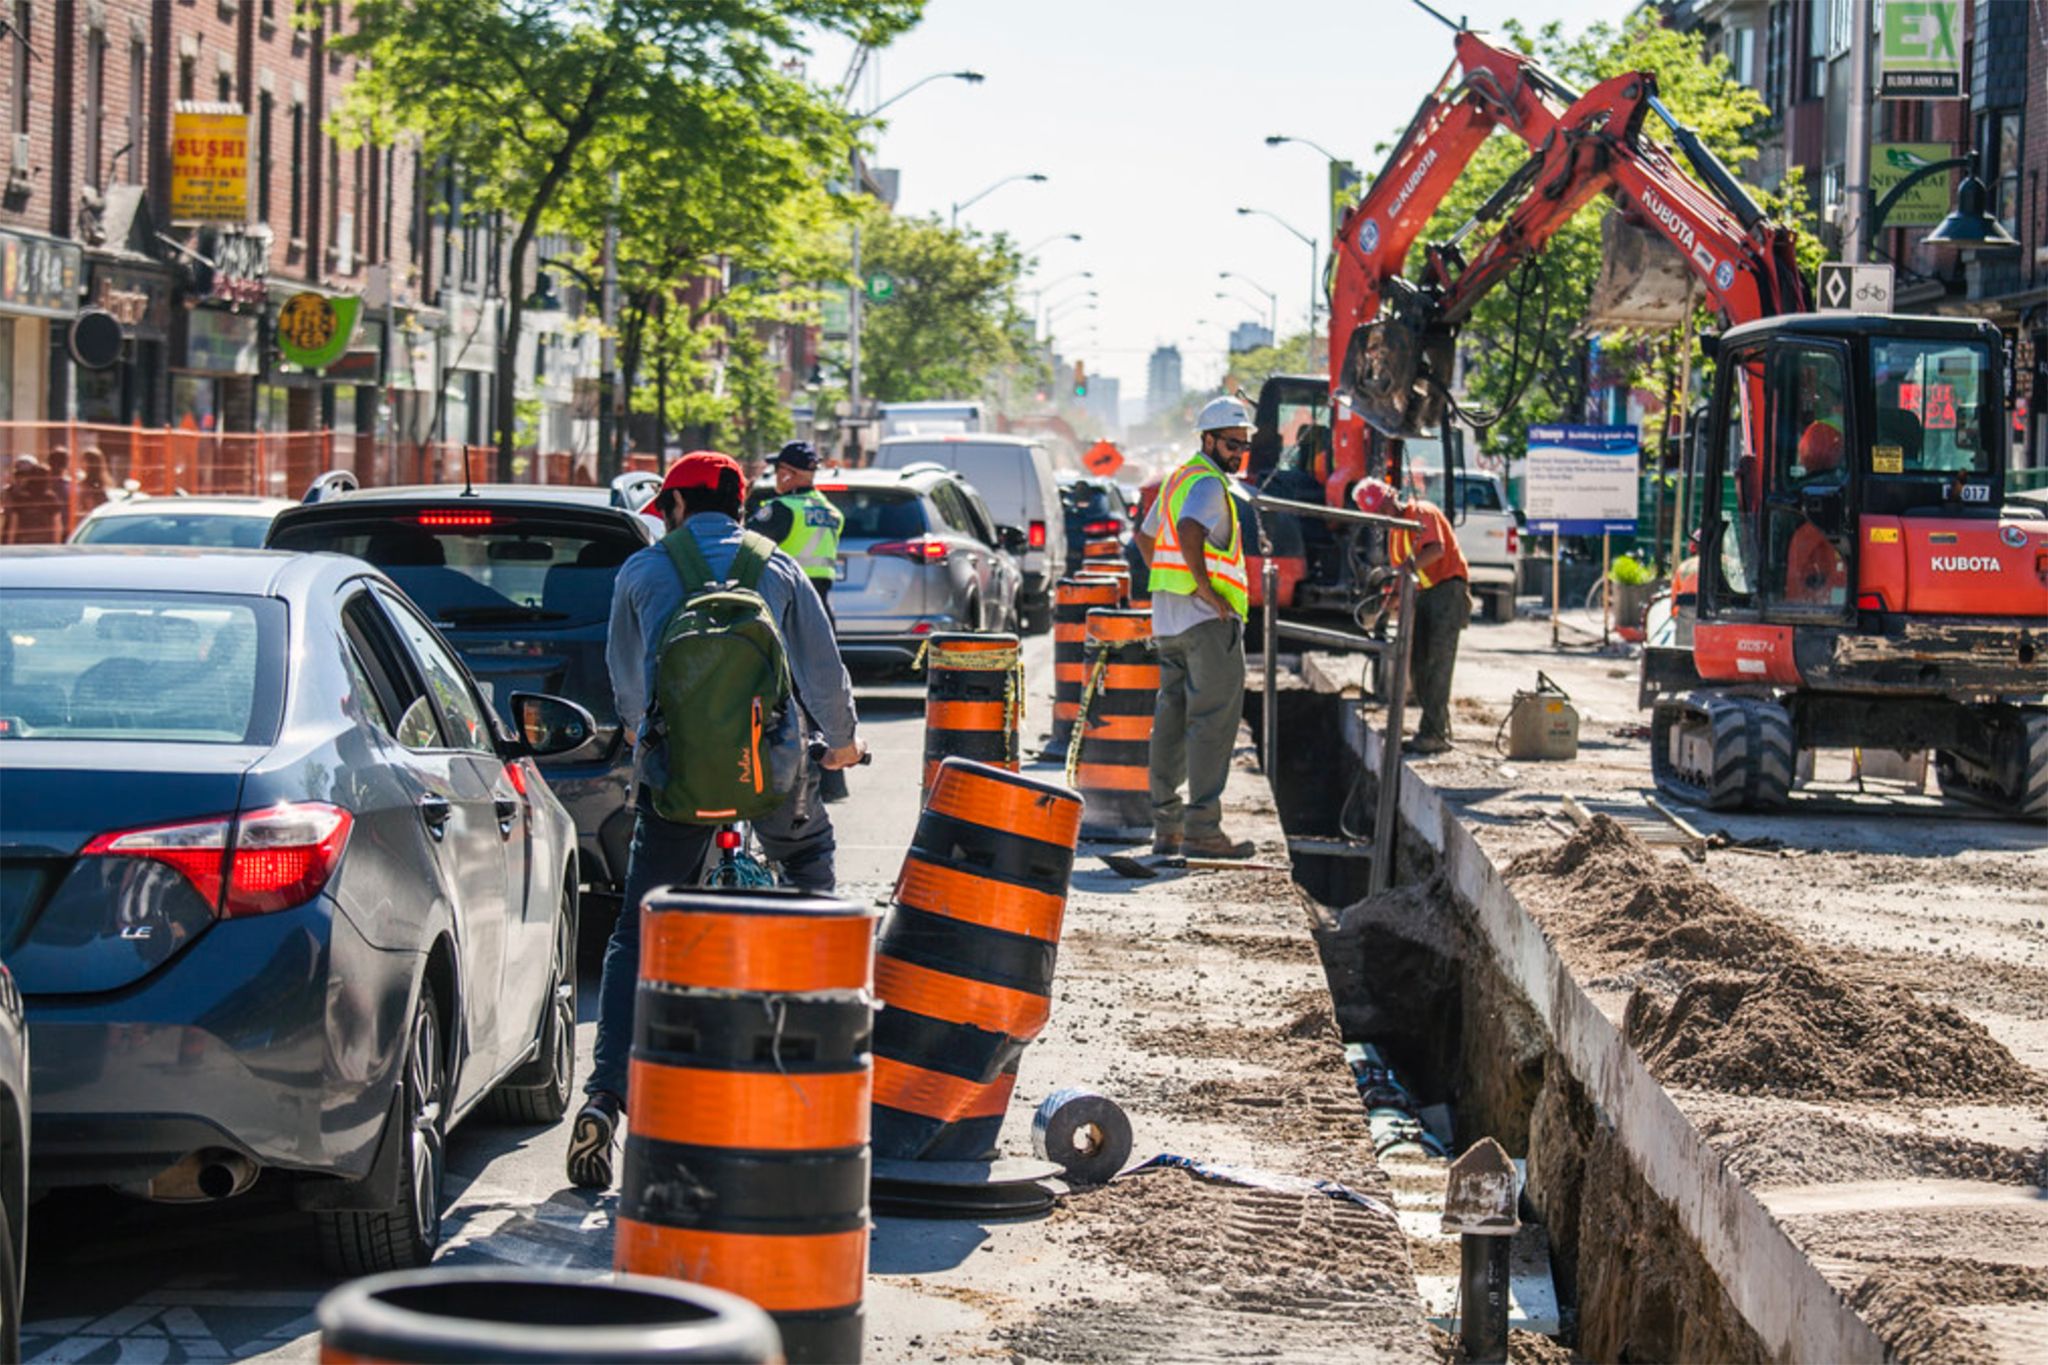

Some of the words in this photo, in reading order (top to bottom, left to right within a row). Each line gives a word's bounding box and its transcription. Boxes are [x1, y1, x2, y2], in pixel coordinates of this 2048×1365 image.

[1884, 2, 1957, 59] EX
[176, 139, 245, 158] SUSHI
[1400, 148, 1437, 202] KUBOTA
[1642, 187, 1695, 250] KUBOTA
[873, 277, 889, 295] P
[806, 508, 838, 525] POLI
[1931, 556, 2000, 571] KUBOTA
[120, 926, 153, 939] LE
